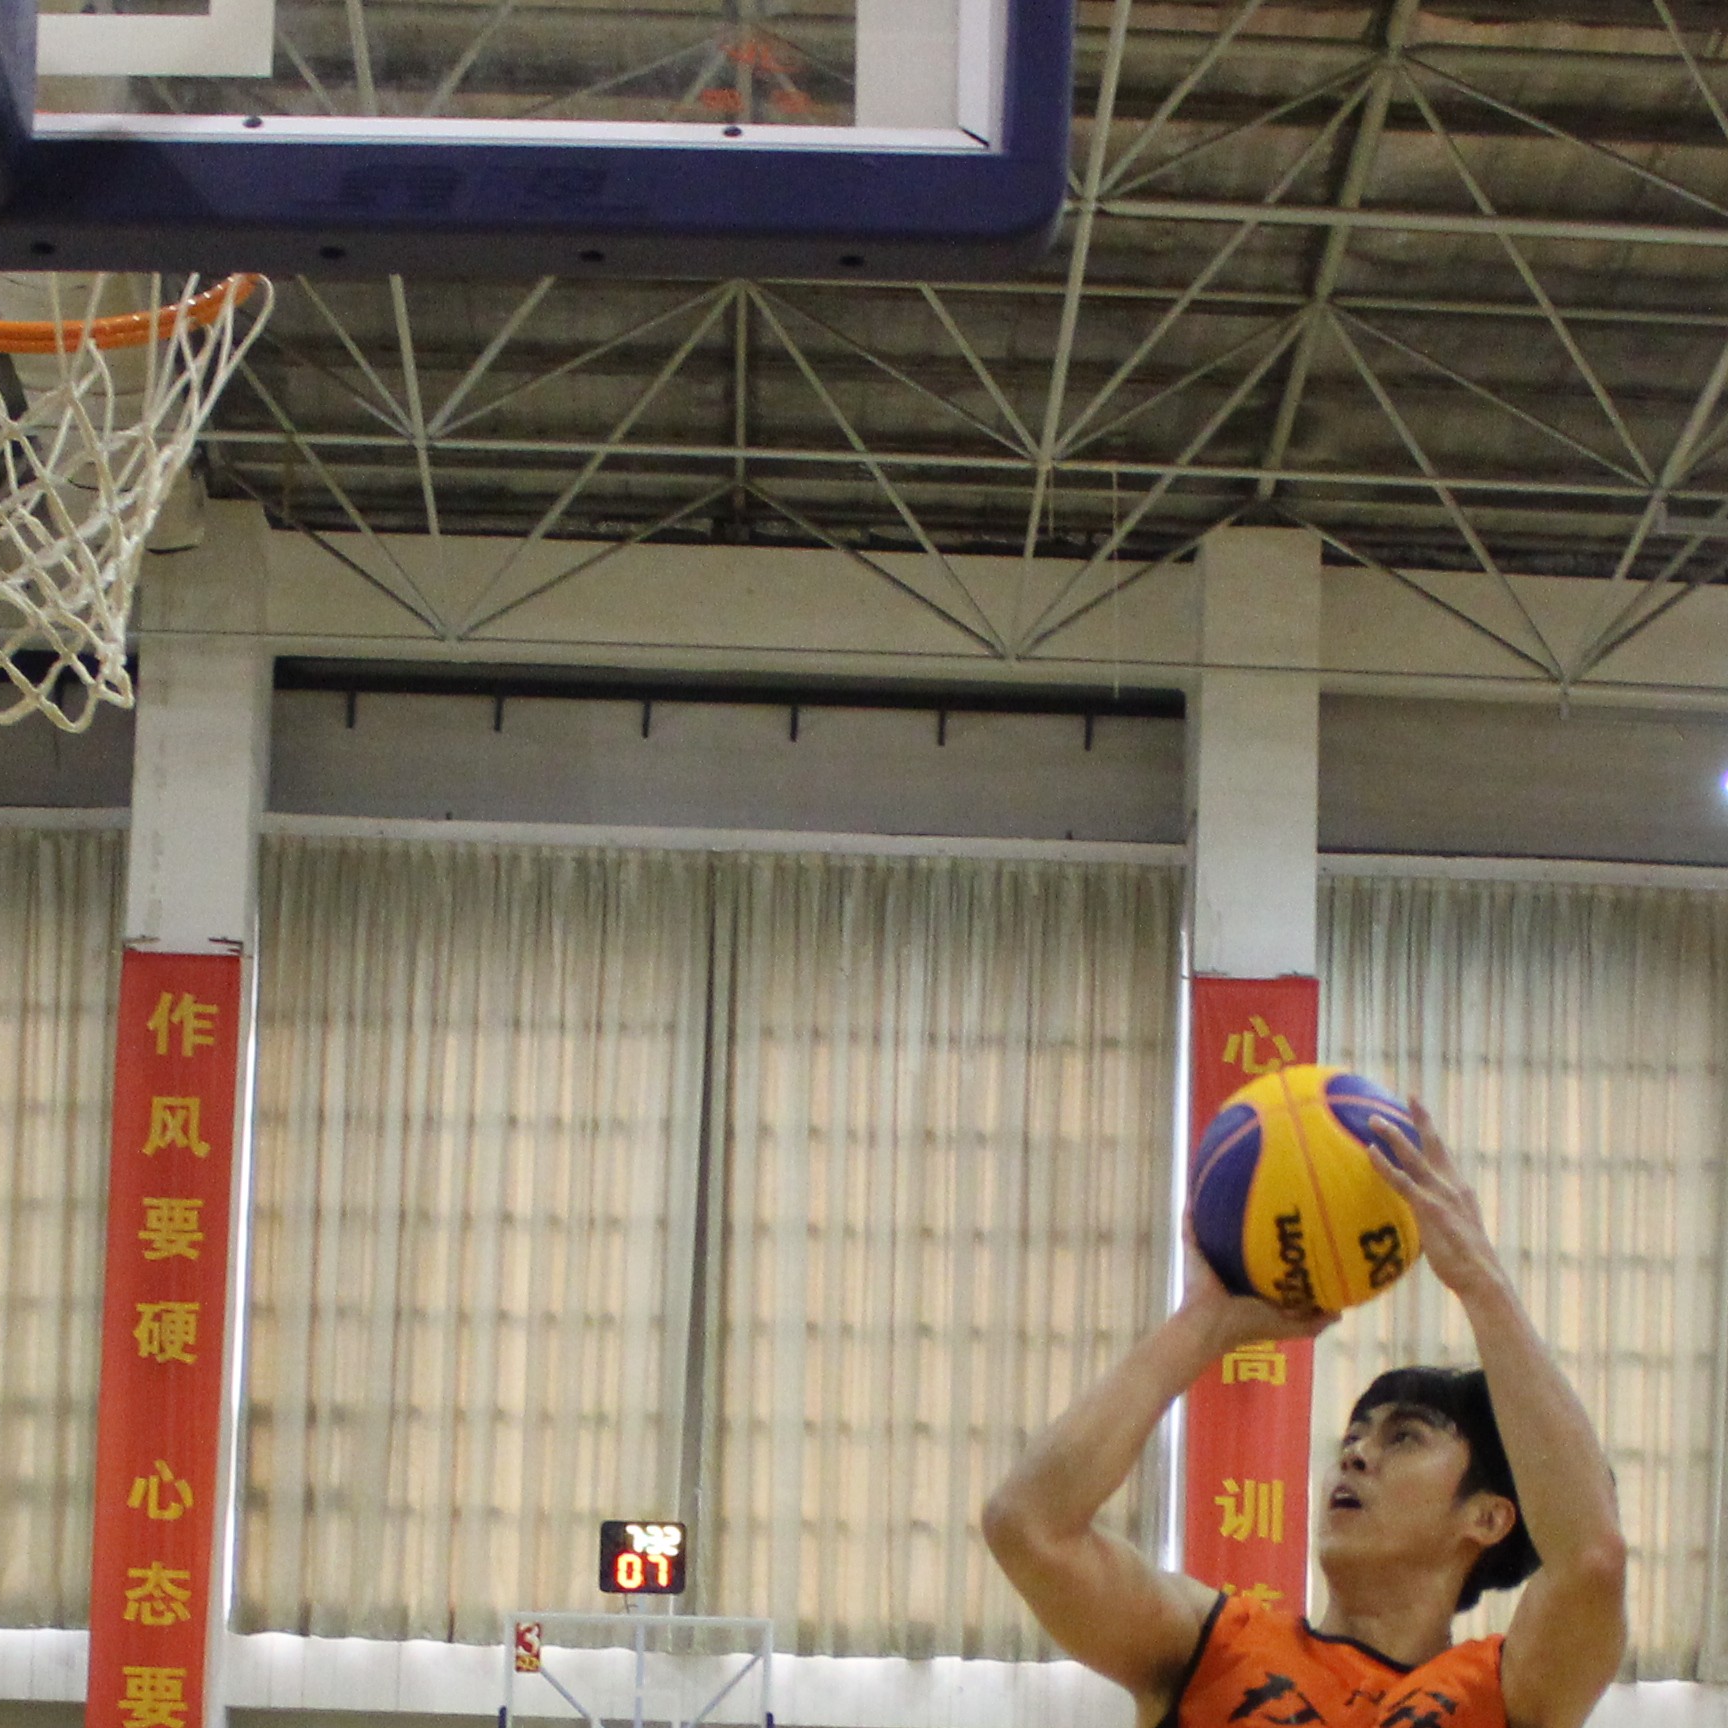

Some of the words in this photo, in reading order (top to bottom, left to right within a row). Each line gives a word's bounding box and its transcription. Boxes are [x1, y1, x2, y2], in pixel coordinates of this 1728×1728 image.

[134, 991, 219, 1366] 作风要硬
[617, 1552, 669, 1589] 07
